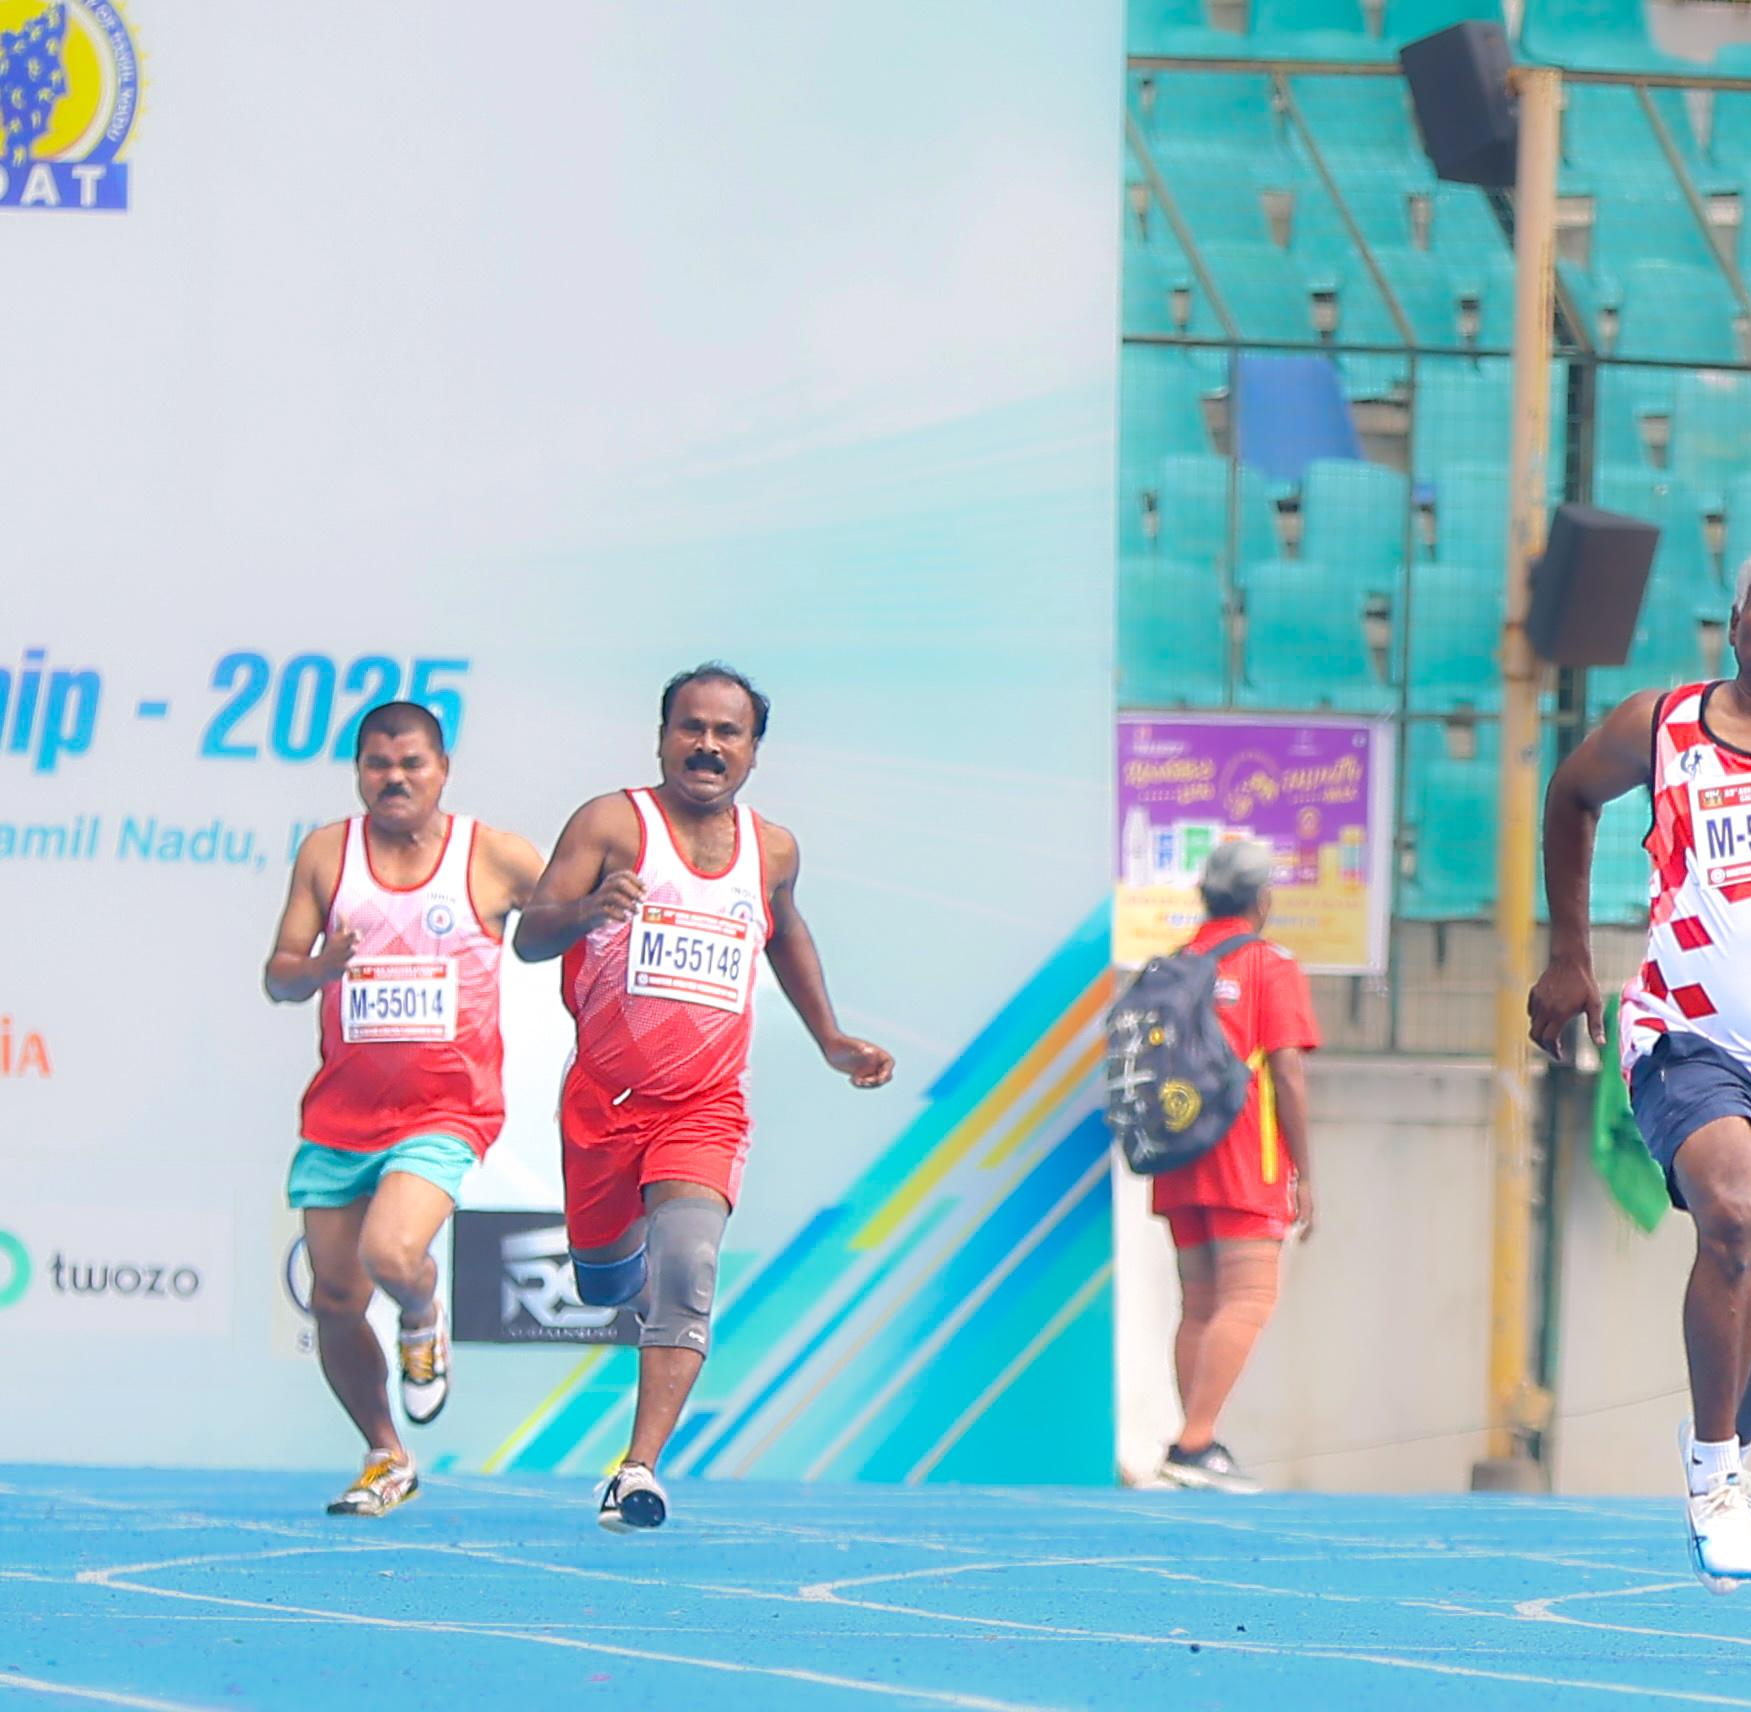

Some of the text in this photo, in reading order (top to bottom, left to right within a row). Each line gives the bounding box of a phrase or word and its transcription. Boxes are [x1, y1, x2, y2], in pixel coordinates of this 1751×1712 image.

[0, 163, 106, 208] AT
[116, 816, 268, 872] Nadu,
[640, 931, 742, 981] M-55148
[350, 986, 443, 1021] M-55014
[51, 1252, 199, 1298] twozo
